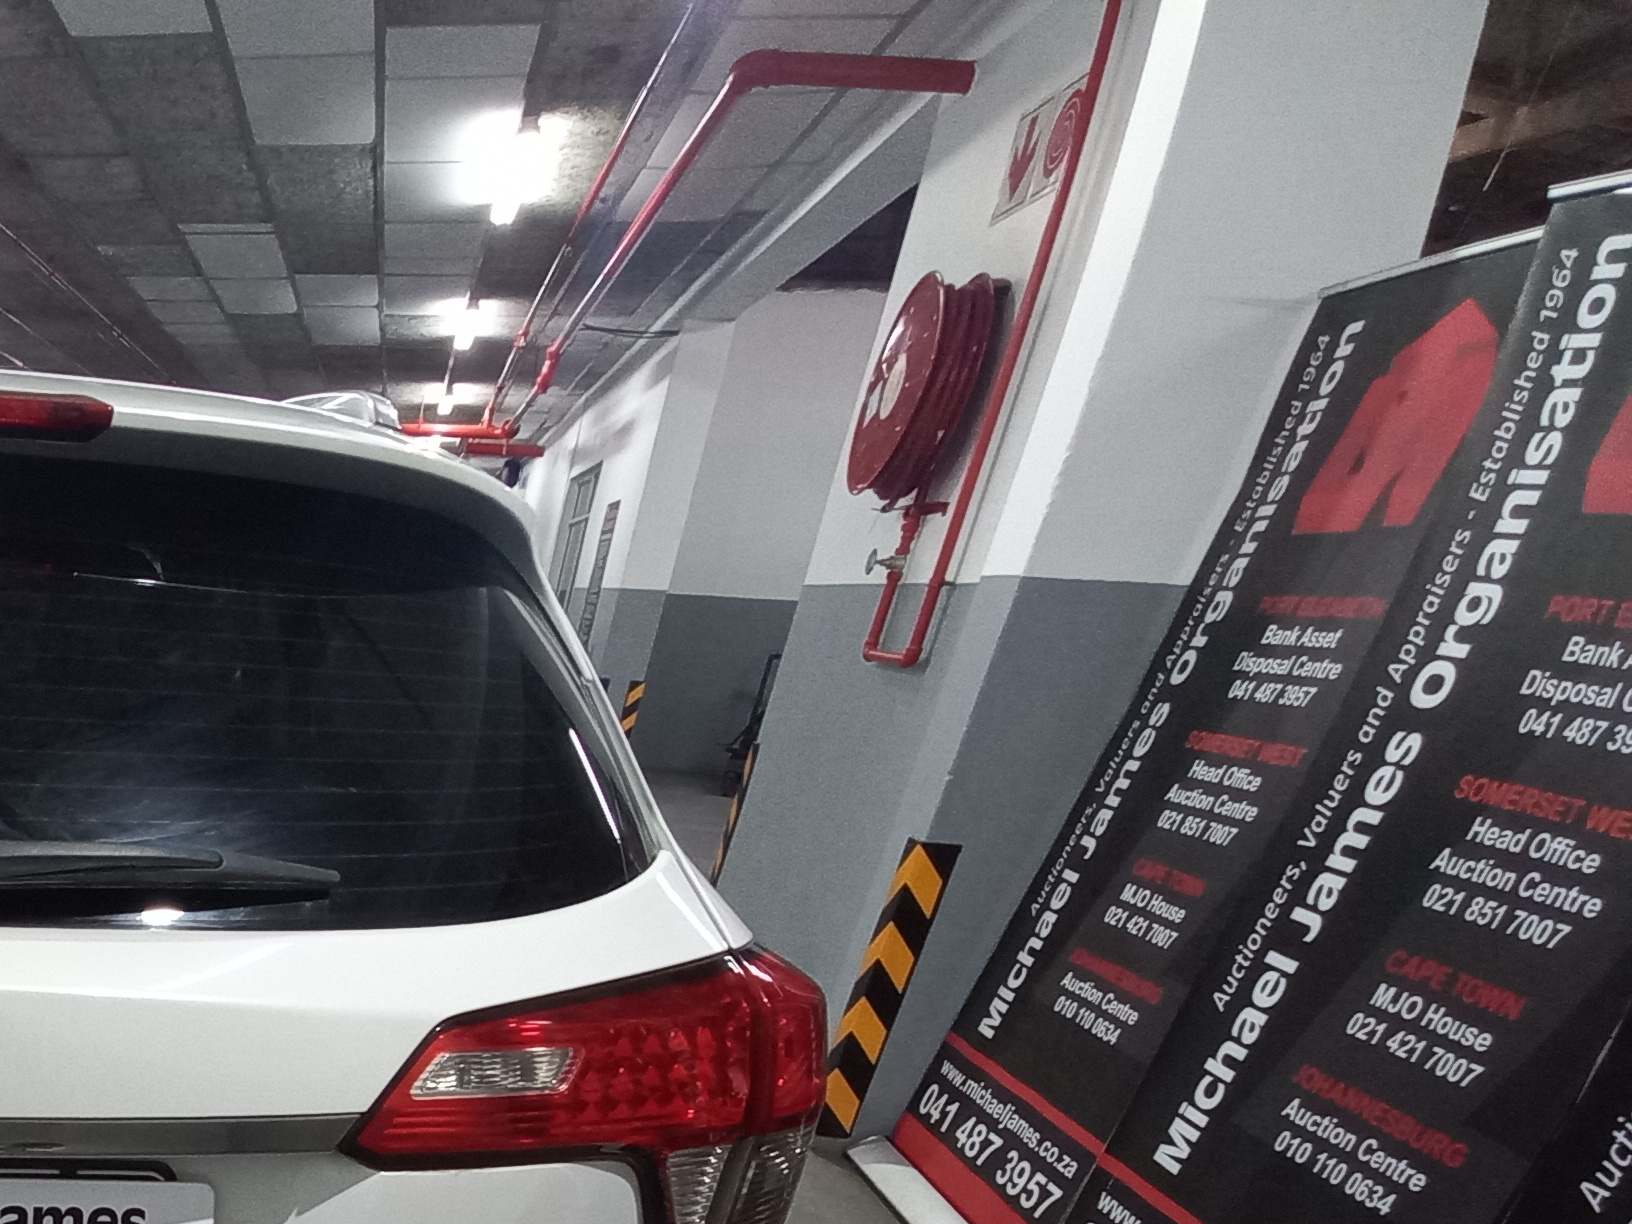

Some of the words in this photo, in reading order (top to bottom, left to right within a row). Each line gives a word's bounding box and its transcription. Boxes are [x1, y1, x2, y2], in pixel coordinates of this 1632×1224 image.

[1095, 719, 1141, 794] Valuers
[1140, 673, 1165, 716] and
[1165, 554, 1230, 669] Appraisers
[1234, 400, 1302, 533] Established
[1298, 334, 1330, 392] 1964
[1212, 859, 1307, 1012] Auctioneers,
[1296, 748, 1363, 848] Valuers
[1358, 686, 1395, 744] and
[1387, 529, 1471, 684] Appraisers
[1469, 329, 1551, 502] Established
[1539, 247, 1580, 323] 1964
[1260, 624, 1300, 646] Bank
[1298, 627, 1344, 649] Asset
[1561, 635, 1626, 670] Bank
[977, 868, 1080, 1039] Michael
[1079, 702, 1171, 860] James
[1169, 320, 1366, 685] Organisation
[1227, 680, 1253, 701] 041
[1253, 682, 1281, 704] 487
[1278, 685, 1317, 708] 3957
[1232, 652, 1293, 677] Disposal
[1292, 658, 1343, 680] Centre
[1520, 669, 1622, 712] Disposal
[1152, 948, 1300, 1176] Michael
[1289, 730, 1423, 943] James
[1409, 233, 1632, 709] Organisation
[1518, 708, 1563, 740] 041
[1563, 716, 1608, 750] 487
[1606, 722, 1632, 754] 39
[1164, 784, 1215, 812] Auction
[1213, 796, 1259, 823] Centre
[1187, 759, 1227, 785] Head
[1222, 766, 1263, 792] Office
[1156, 809, 1183, 832] 021
[1180, 815, 1206, 839] 851
[1204, 821, 1239, 847] 7007
[1465, 816, 1532, 856] Head
[1528, 831, 1602, 875] Office
[1585, 805, 1632, 840] WE
[1119, 882, 1152, 908] MJO
[1147, 894, 1187, 924] House
[1428, 847, 1517, 893] Auction
[1517, 871, 1603, 919] Centre
[1104, 905, 1130, 929] 021
[1126, 915, 1153, 938] 421
[1147, 923, 1179, 950] 7007
[1422, 883, 1466, 916] 021
[1463, 894, 1509, 930] 851
[1505, 908, 1573, 950] 7007
[1053, 995, 1079, 1022] 010
[1077, 1007, 1096, 1031] 110
[1091, 1017, 1122, 1046] 0634
[1060, 971, 1105, 1005] Auction
[1101, 992, 1139, 1026] Centre
[1369, 982, 1424, 1020] MJO
[1420, 1002, 1494, 1053] House
[1345, 1011, 1389, 1046] 021
[1385, 1030, 1428, 1063] 421
[1423, 1046, 1486, 1088] 7007
[939, 1059, 1078, 1180] www.michaeljames.co.za
[1280, 1098, 1358, 1152] Auction
[1358, 1138, 1427, 1192] Centre
[919, 1083, 961, 1134] 041
[955, 1116, 1005, 1167] 487
[995, 1150, 1064, 1220] 3957
[1274, 1130, 1313, 1164] 010
[1312, 1152, 1350, 1186] 110
[1344, 1171, 1397, 1216] 0634
[1579, 1115, 1632, 1214] Auct
